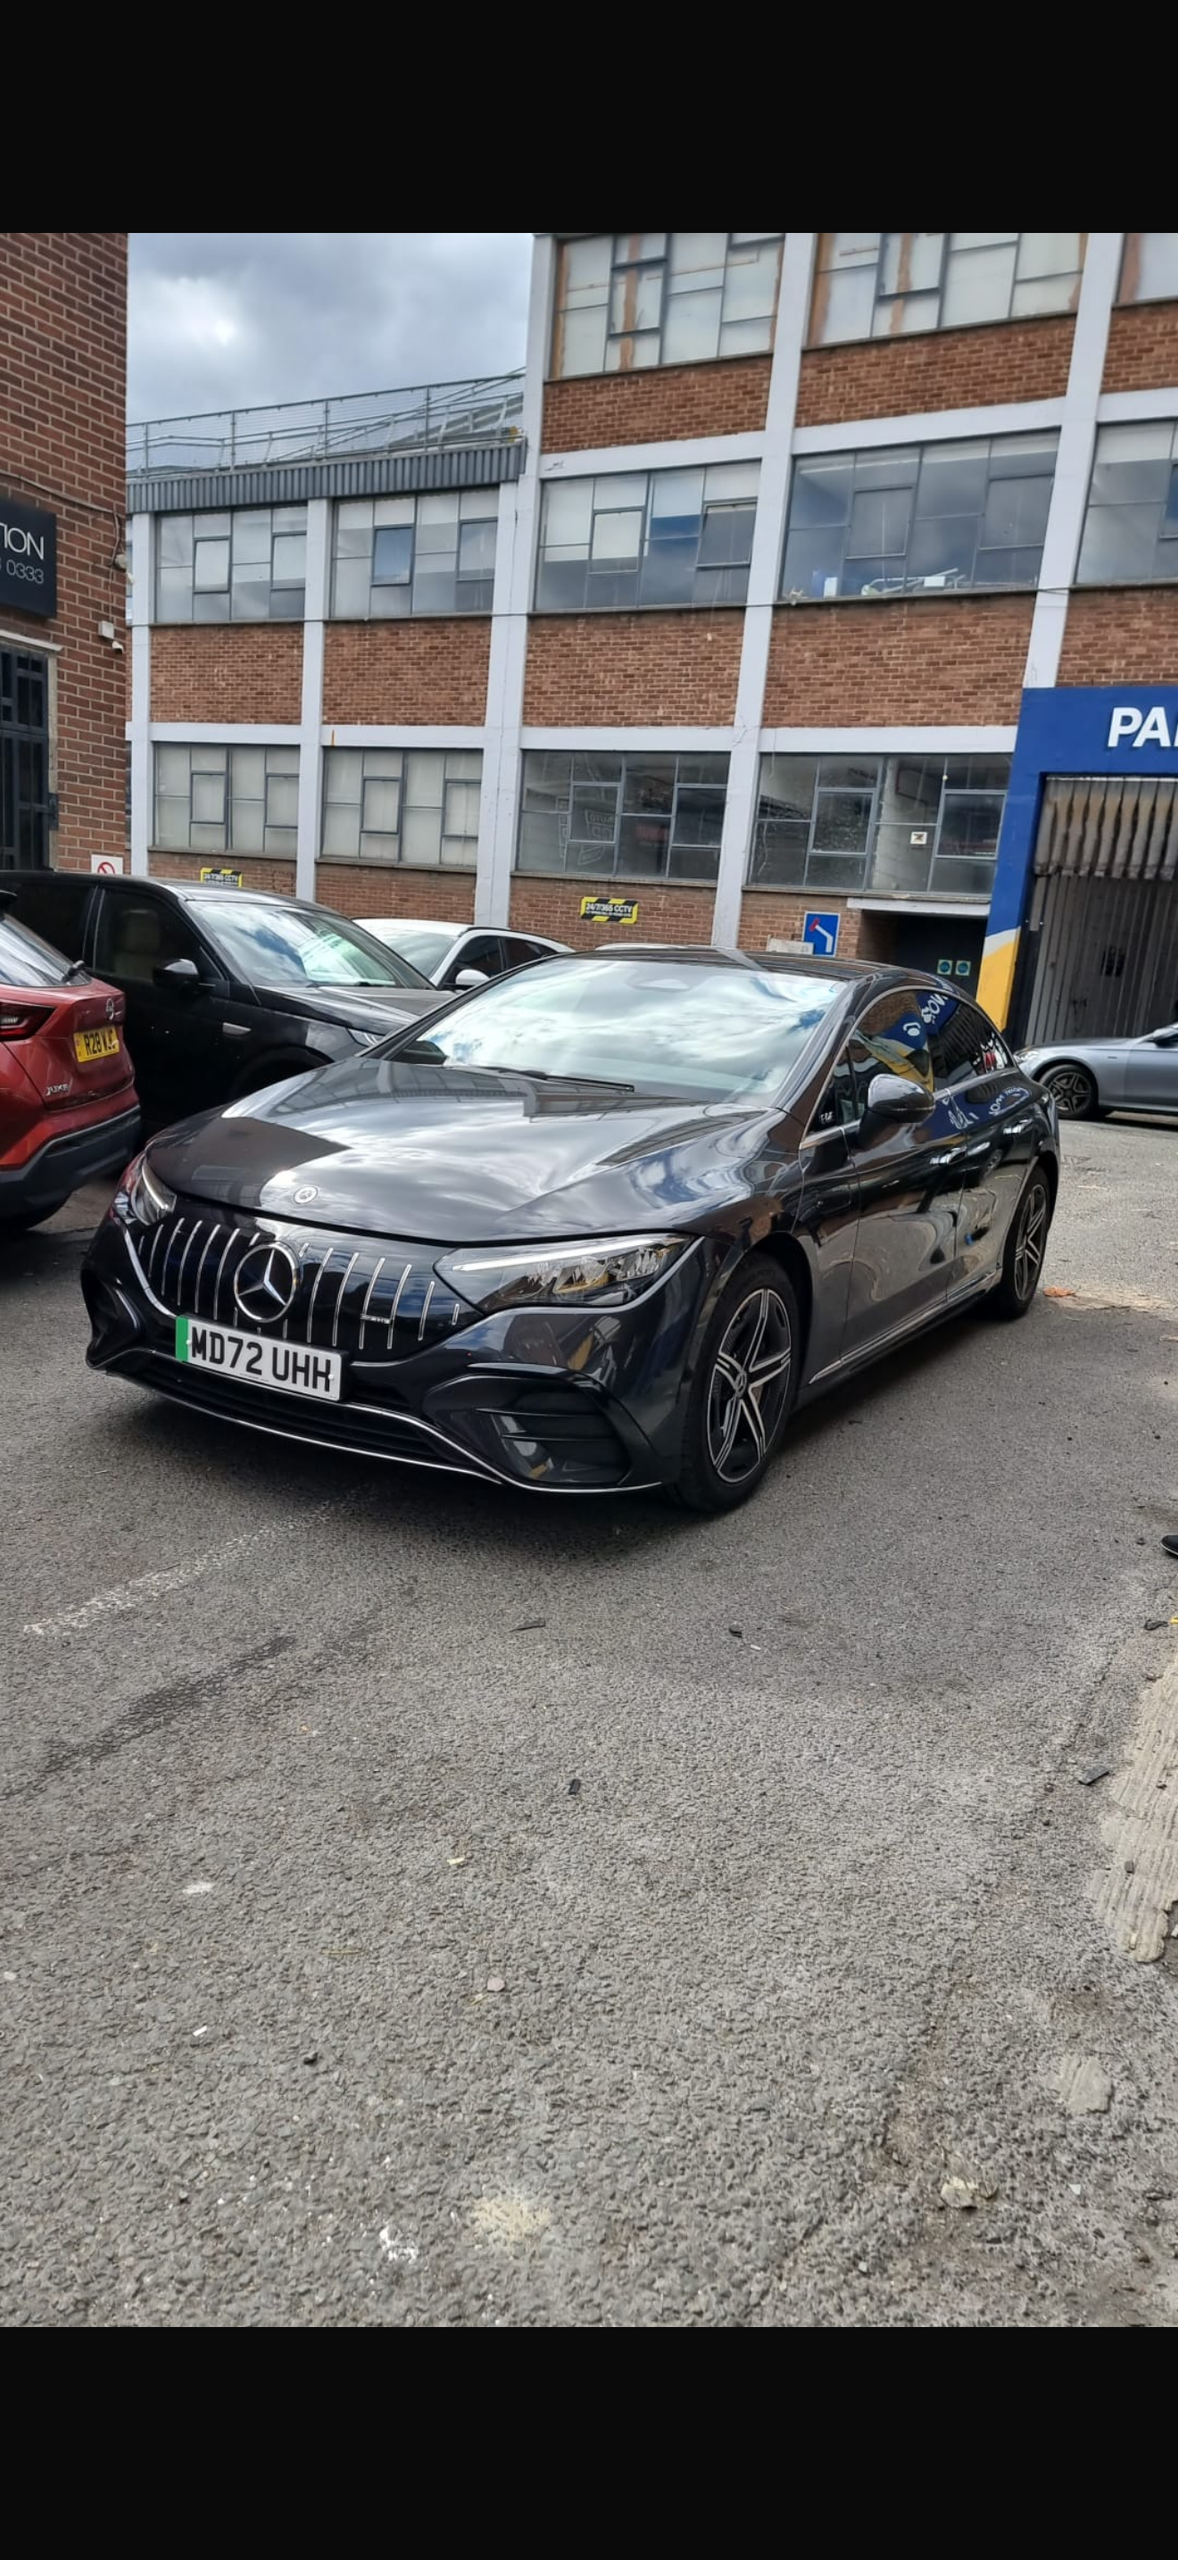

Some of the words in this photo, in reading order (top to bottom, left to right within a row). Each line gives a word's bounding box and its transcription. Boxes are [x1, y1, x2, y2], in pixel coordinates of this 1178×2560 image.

[6, 559, 44, 584] 0333
[1107, 706, 1178, 748] PA
[614, 904, 632, 912] CCTV
[84, 1031, 104, 1056] R28
[191, 1326, 263, 1376] MD72
[272, 1346, 332, 1392] UHH
